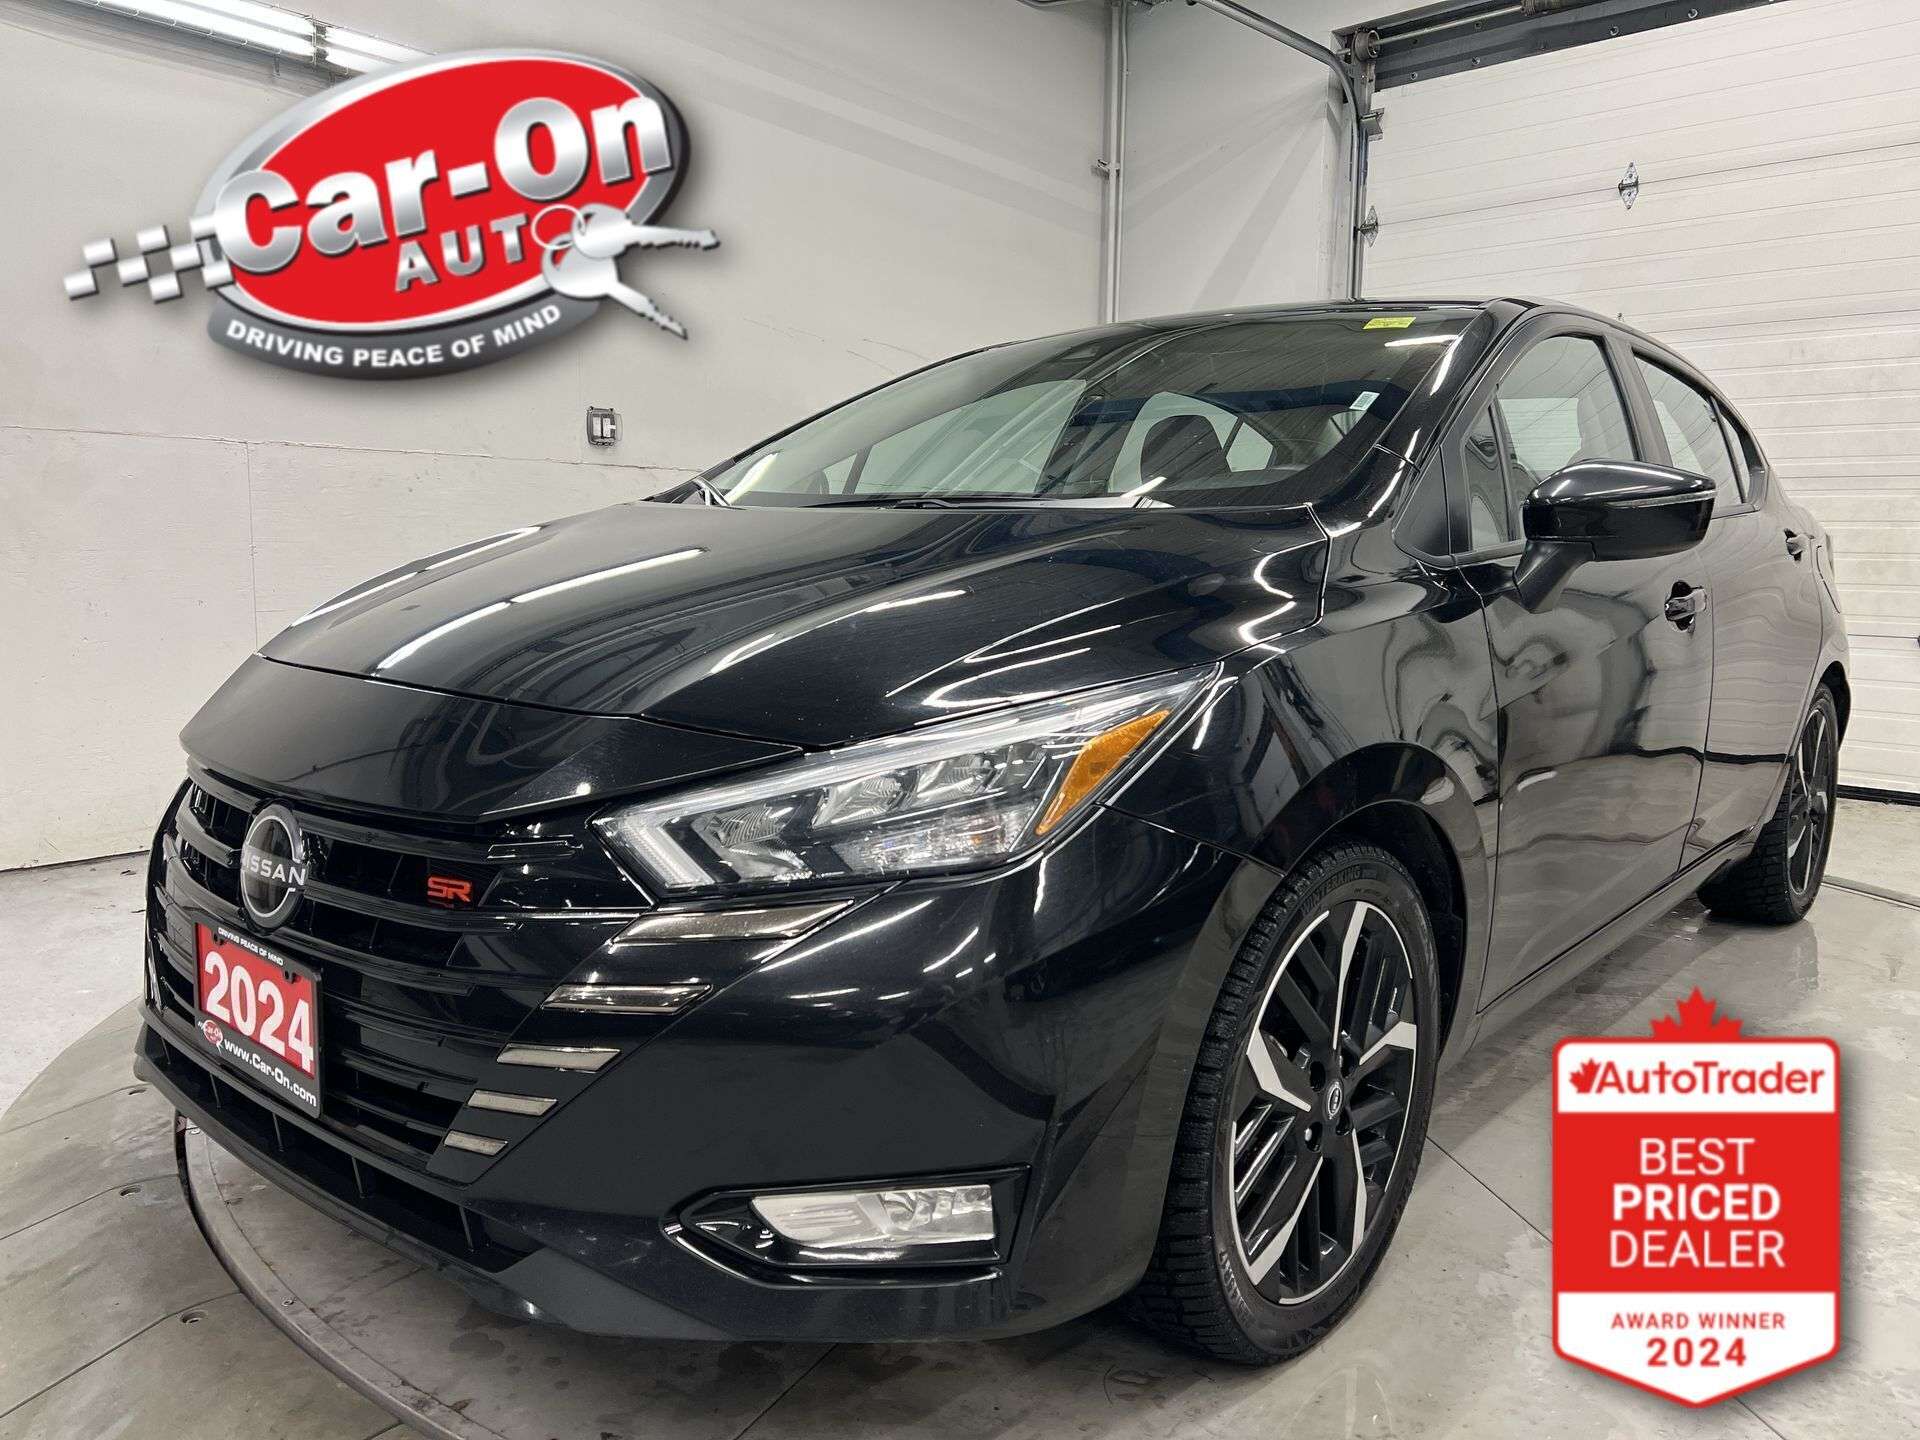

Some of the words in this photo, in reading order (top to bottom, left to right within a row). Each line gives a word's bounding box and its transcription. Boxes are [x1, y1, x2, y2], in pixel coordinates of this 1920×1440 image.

[427, 875, 472, 903] SR
[204, 951, 315, 1073] 2024
[224, 1038, 317, 1108] www.Car-On.com
